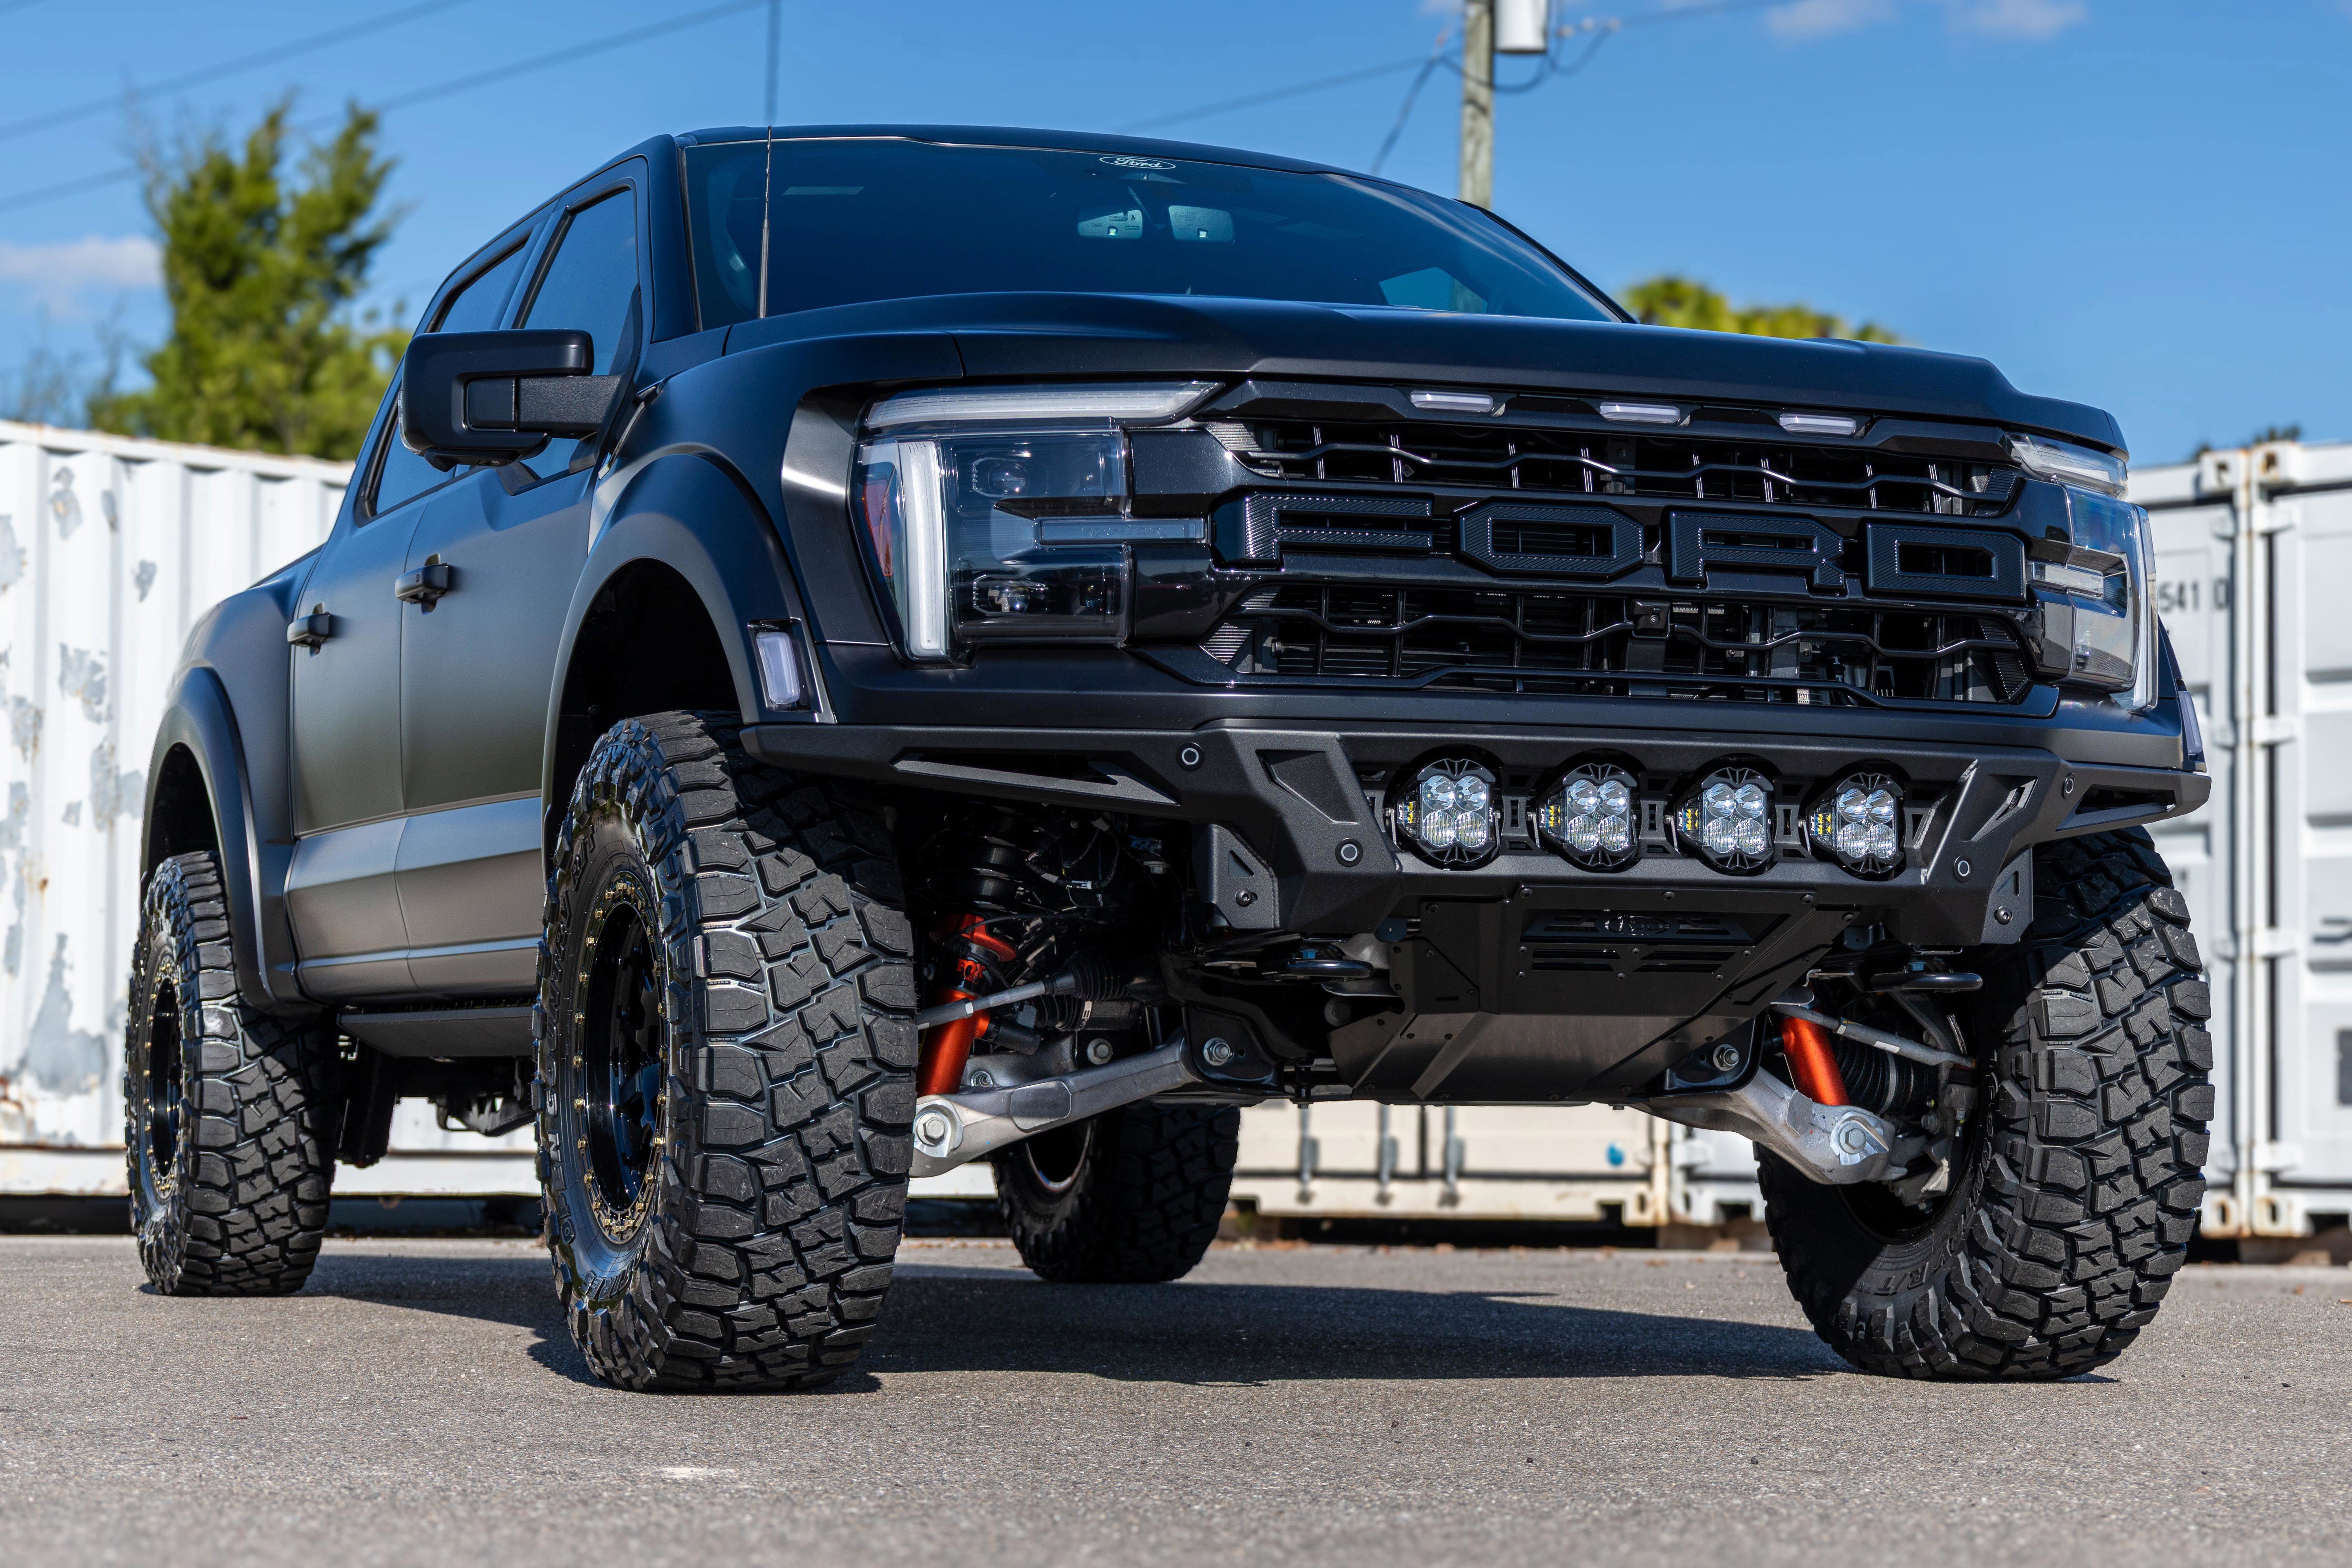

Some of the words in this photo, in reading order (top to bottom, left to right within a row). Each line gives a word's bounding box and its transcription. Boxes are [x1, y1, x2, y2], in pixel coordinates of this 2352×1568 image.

[1114, 158, 1163, 168] Ford
[1241, 492, 2027, 602] FORD
[545, 889, 571, 1118] COUNTRY
[956, 958, 986, 984] FOX
[547, 1129, 575, 1245] OPEN
